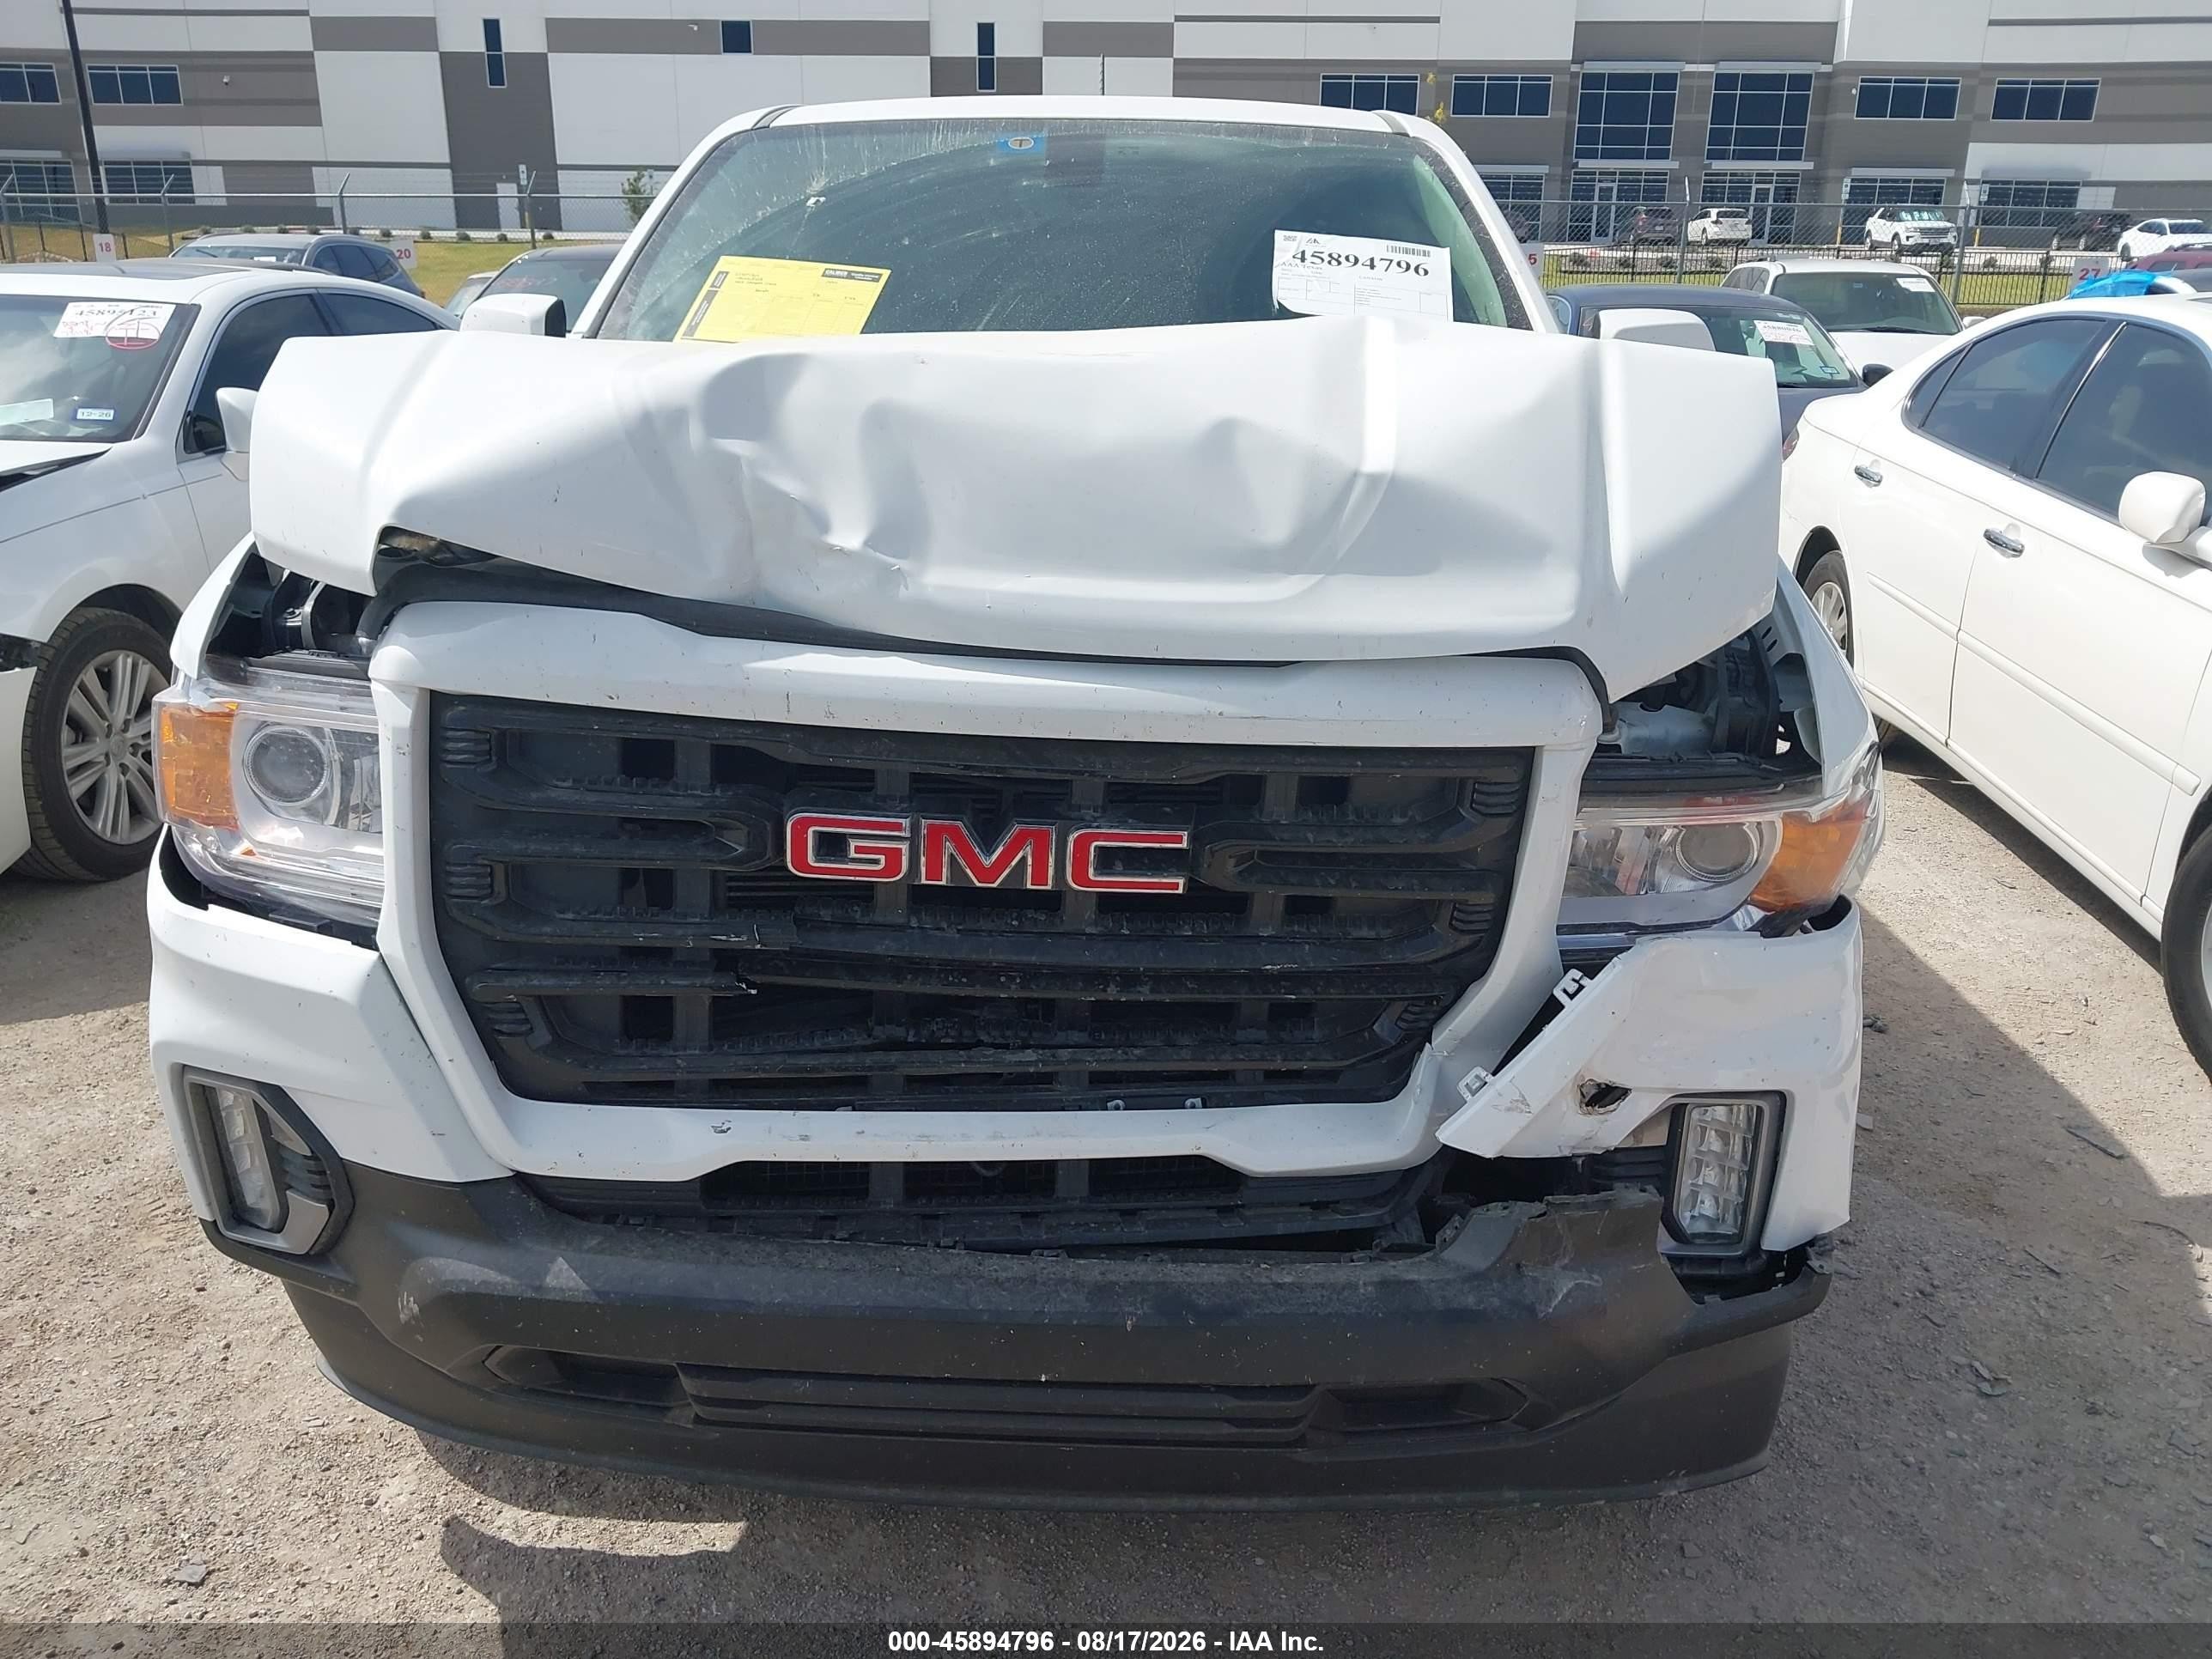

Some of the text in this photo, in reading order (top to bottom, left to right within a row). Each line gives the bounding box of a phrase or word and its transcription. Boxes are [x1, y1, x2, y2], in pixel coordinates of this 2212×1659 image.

[99, 242, 112, 252] 18
[397, 248, 411, 259] 20
[1292, 250, 1429, 276] 45894796
[2079, 268, 2100, 281] 27
[787, 812, 1189, 894] GMC
